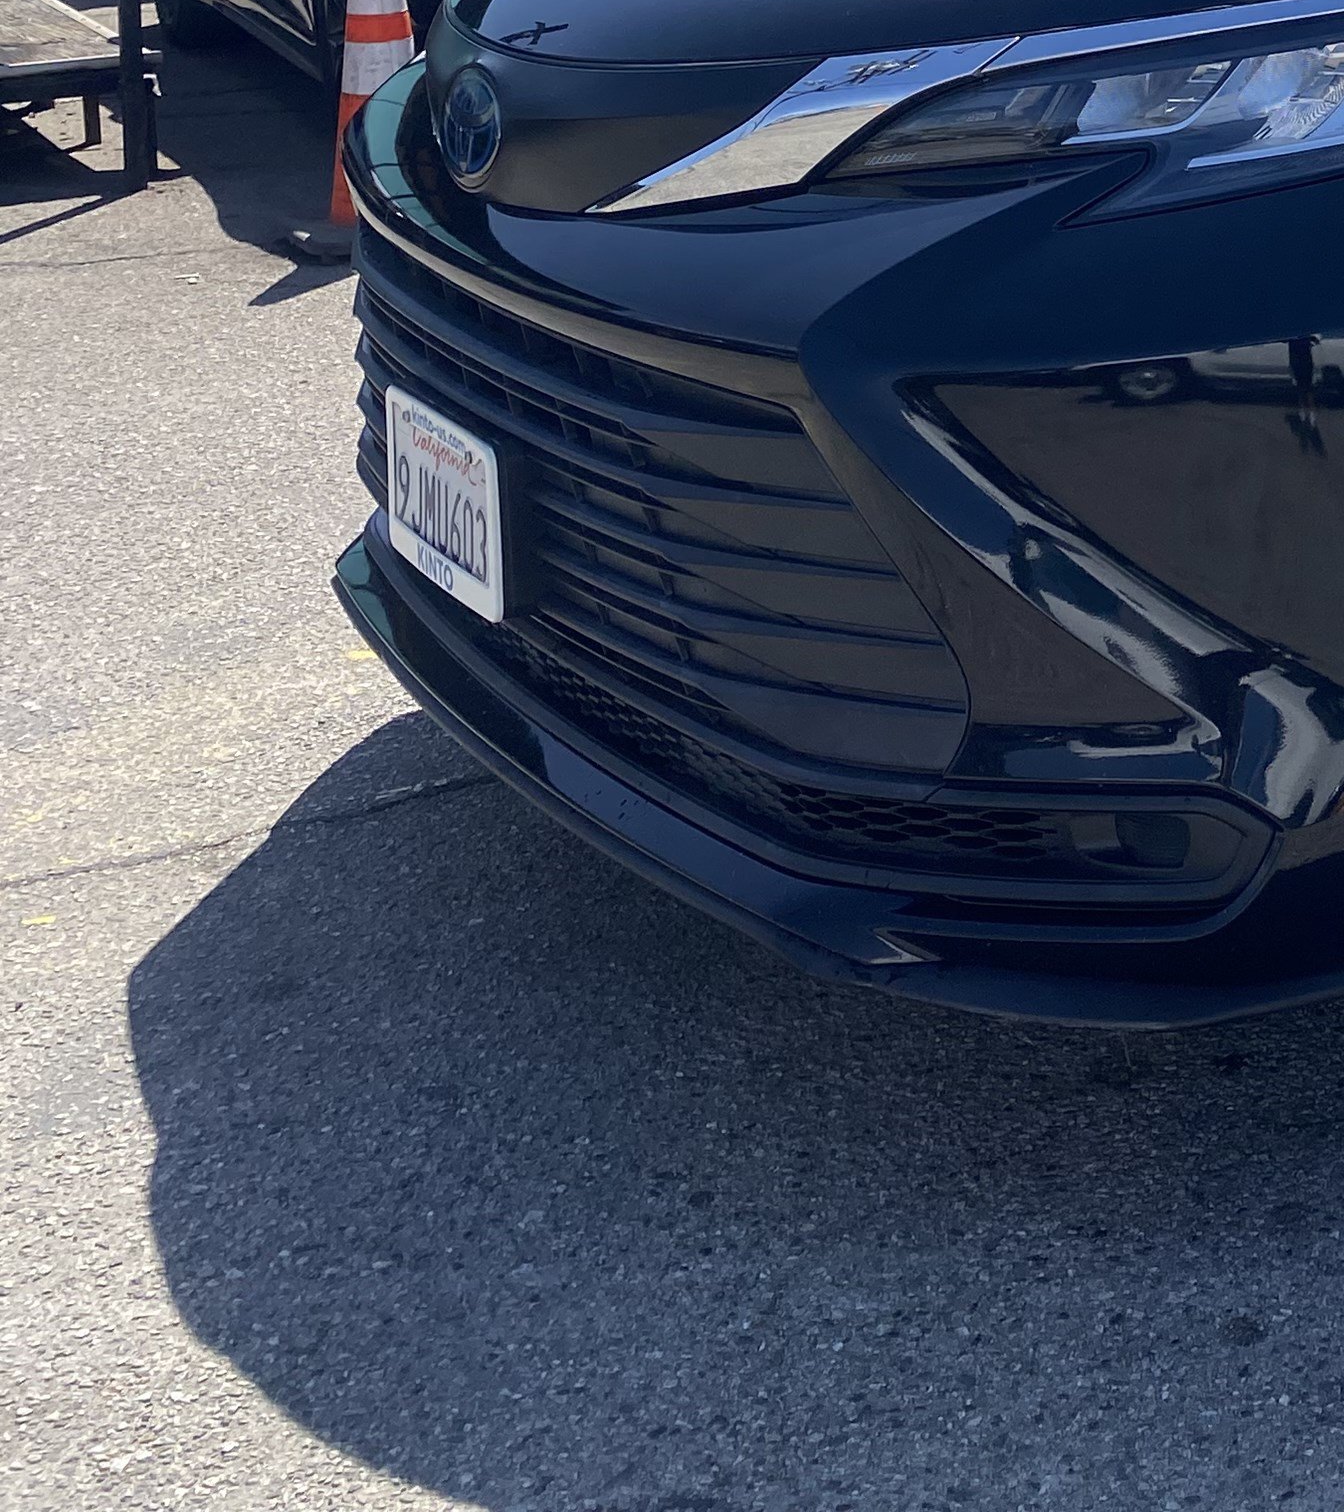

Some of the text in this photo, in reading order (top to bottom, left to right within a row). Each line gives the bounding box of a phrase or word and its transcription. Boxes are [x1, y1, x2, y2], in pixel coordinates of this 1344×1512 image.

[411, 404, 466, 457] kinto-us.com
[412, 426, 472, 478] California
[398, 454, 488, 584] 9JMU603
[417, 542, 454, 591] KINTO
